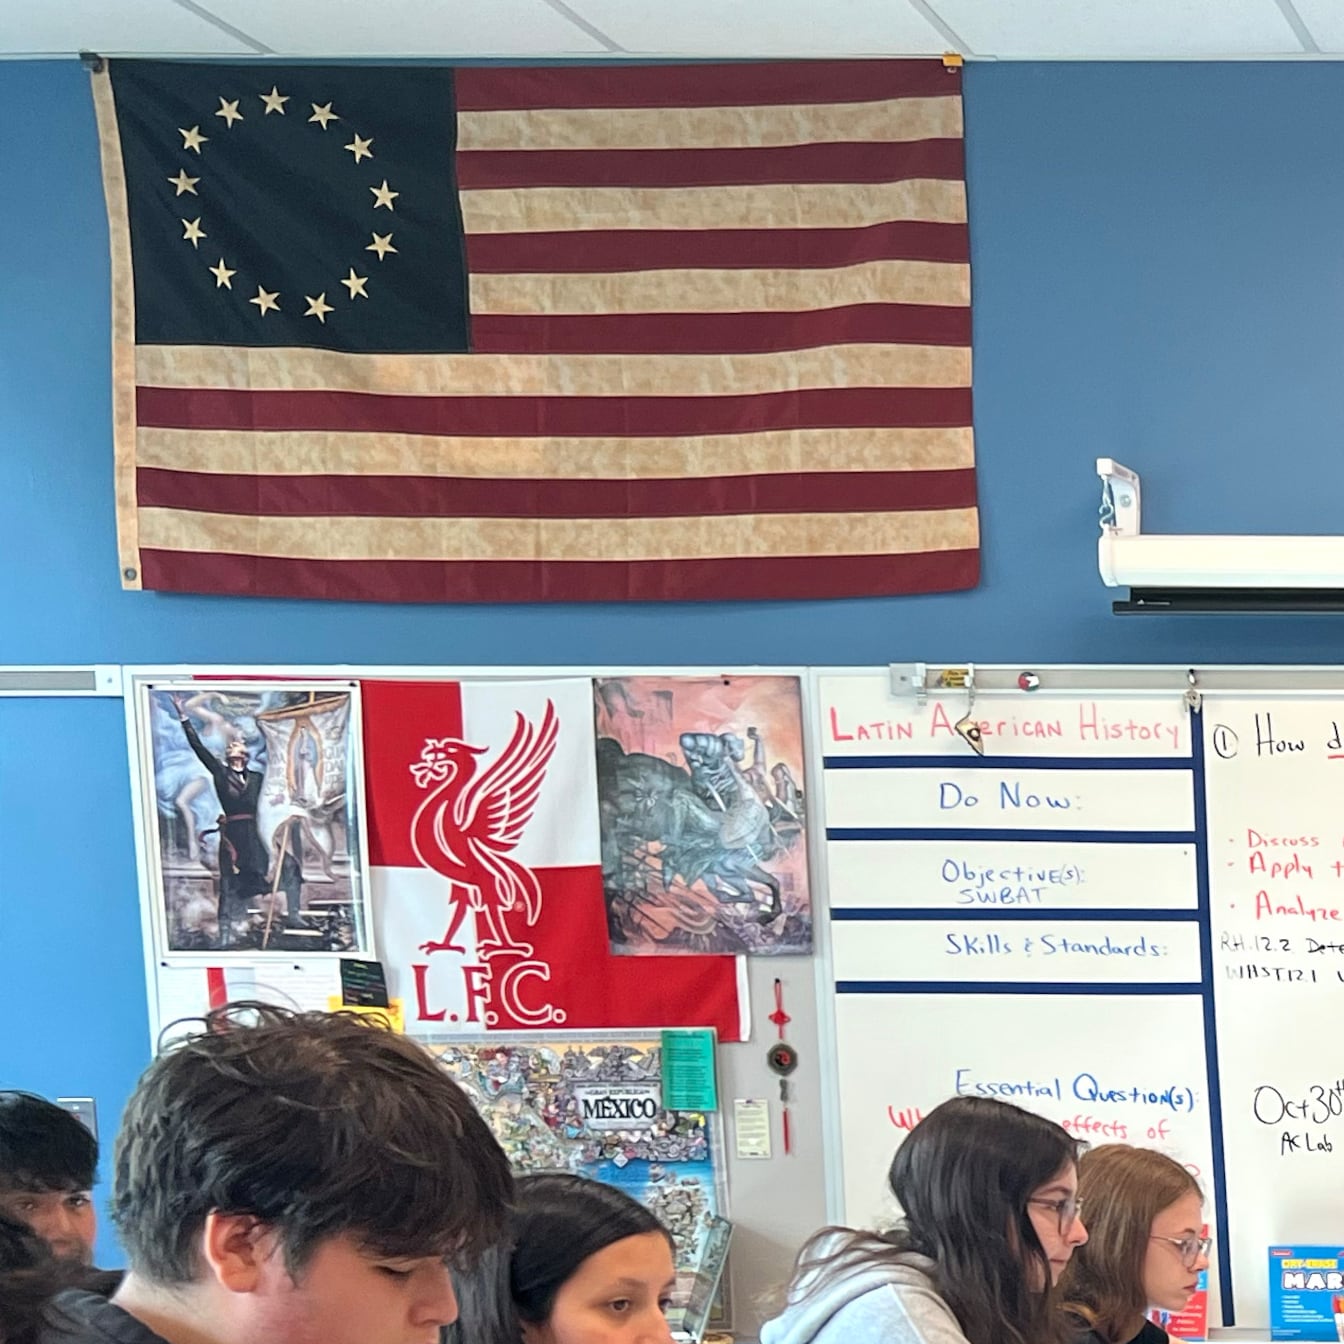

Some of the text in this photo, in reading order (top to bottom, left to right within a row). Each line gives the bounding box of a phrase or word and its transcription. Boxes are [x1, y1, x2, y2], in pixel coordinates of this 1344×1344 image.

[1256, 713, 1305, 756] How
[938, 782, 979, 810] Do
[1248, 829, 1320, 848] Discuss
[1249, 851, 1314, 879] Apply
[959, 886, 1047, 905] SWBAT
[1255, 889, 1344, 922] Analyze
[945, 932, 1013, 956] Skills
[411, 961, 568, 1026] L.F.C.
[956, 1068, 1062, 1099] Essential
[1254, 1084, 1310, 1126] Oct
[1062, 1115, 1172, 1140] effects of
[1306, 1131, 1334, 1154] Lab
